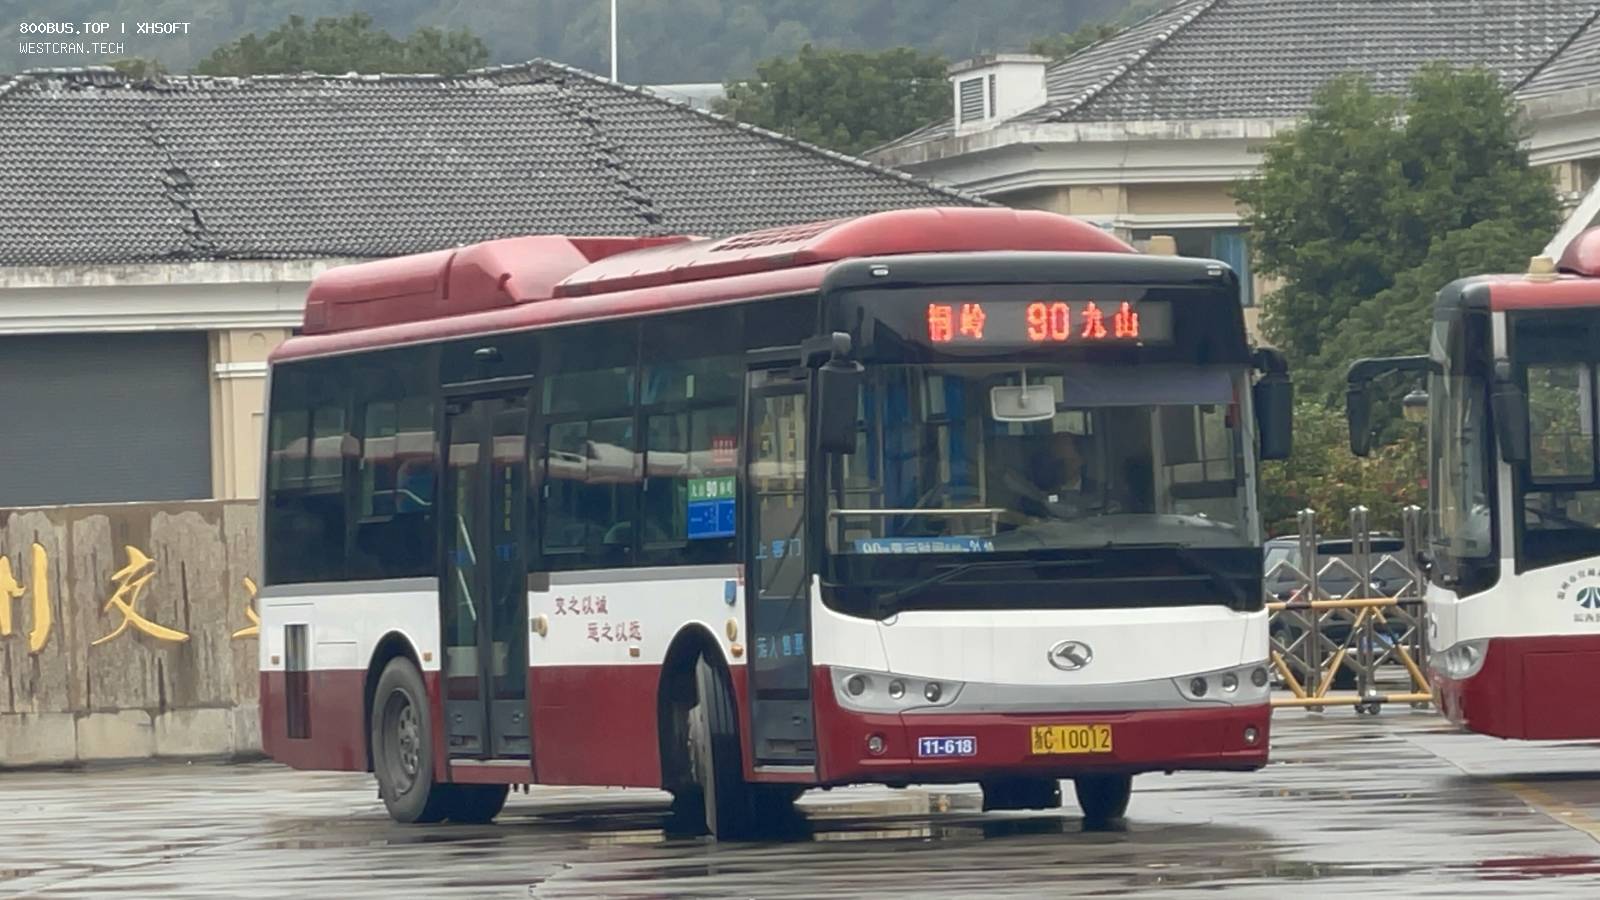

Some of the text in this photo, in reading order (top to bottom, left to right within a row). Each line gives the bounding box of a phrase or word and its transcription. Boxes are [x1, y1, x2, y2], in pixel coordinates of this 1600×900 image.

[1027, 302, 1070, 340] 90
[1081, 301, 1138, 338] 九山
[923, 740, 973, 754] 11-618
